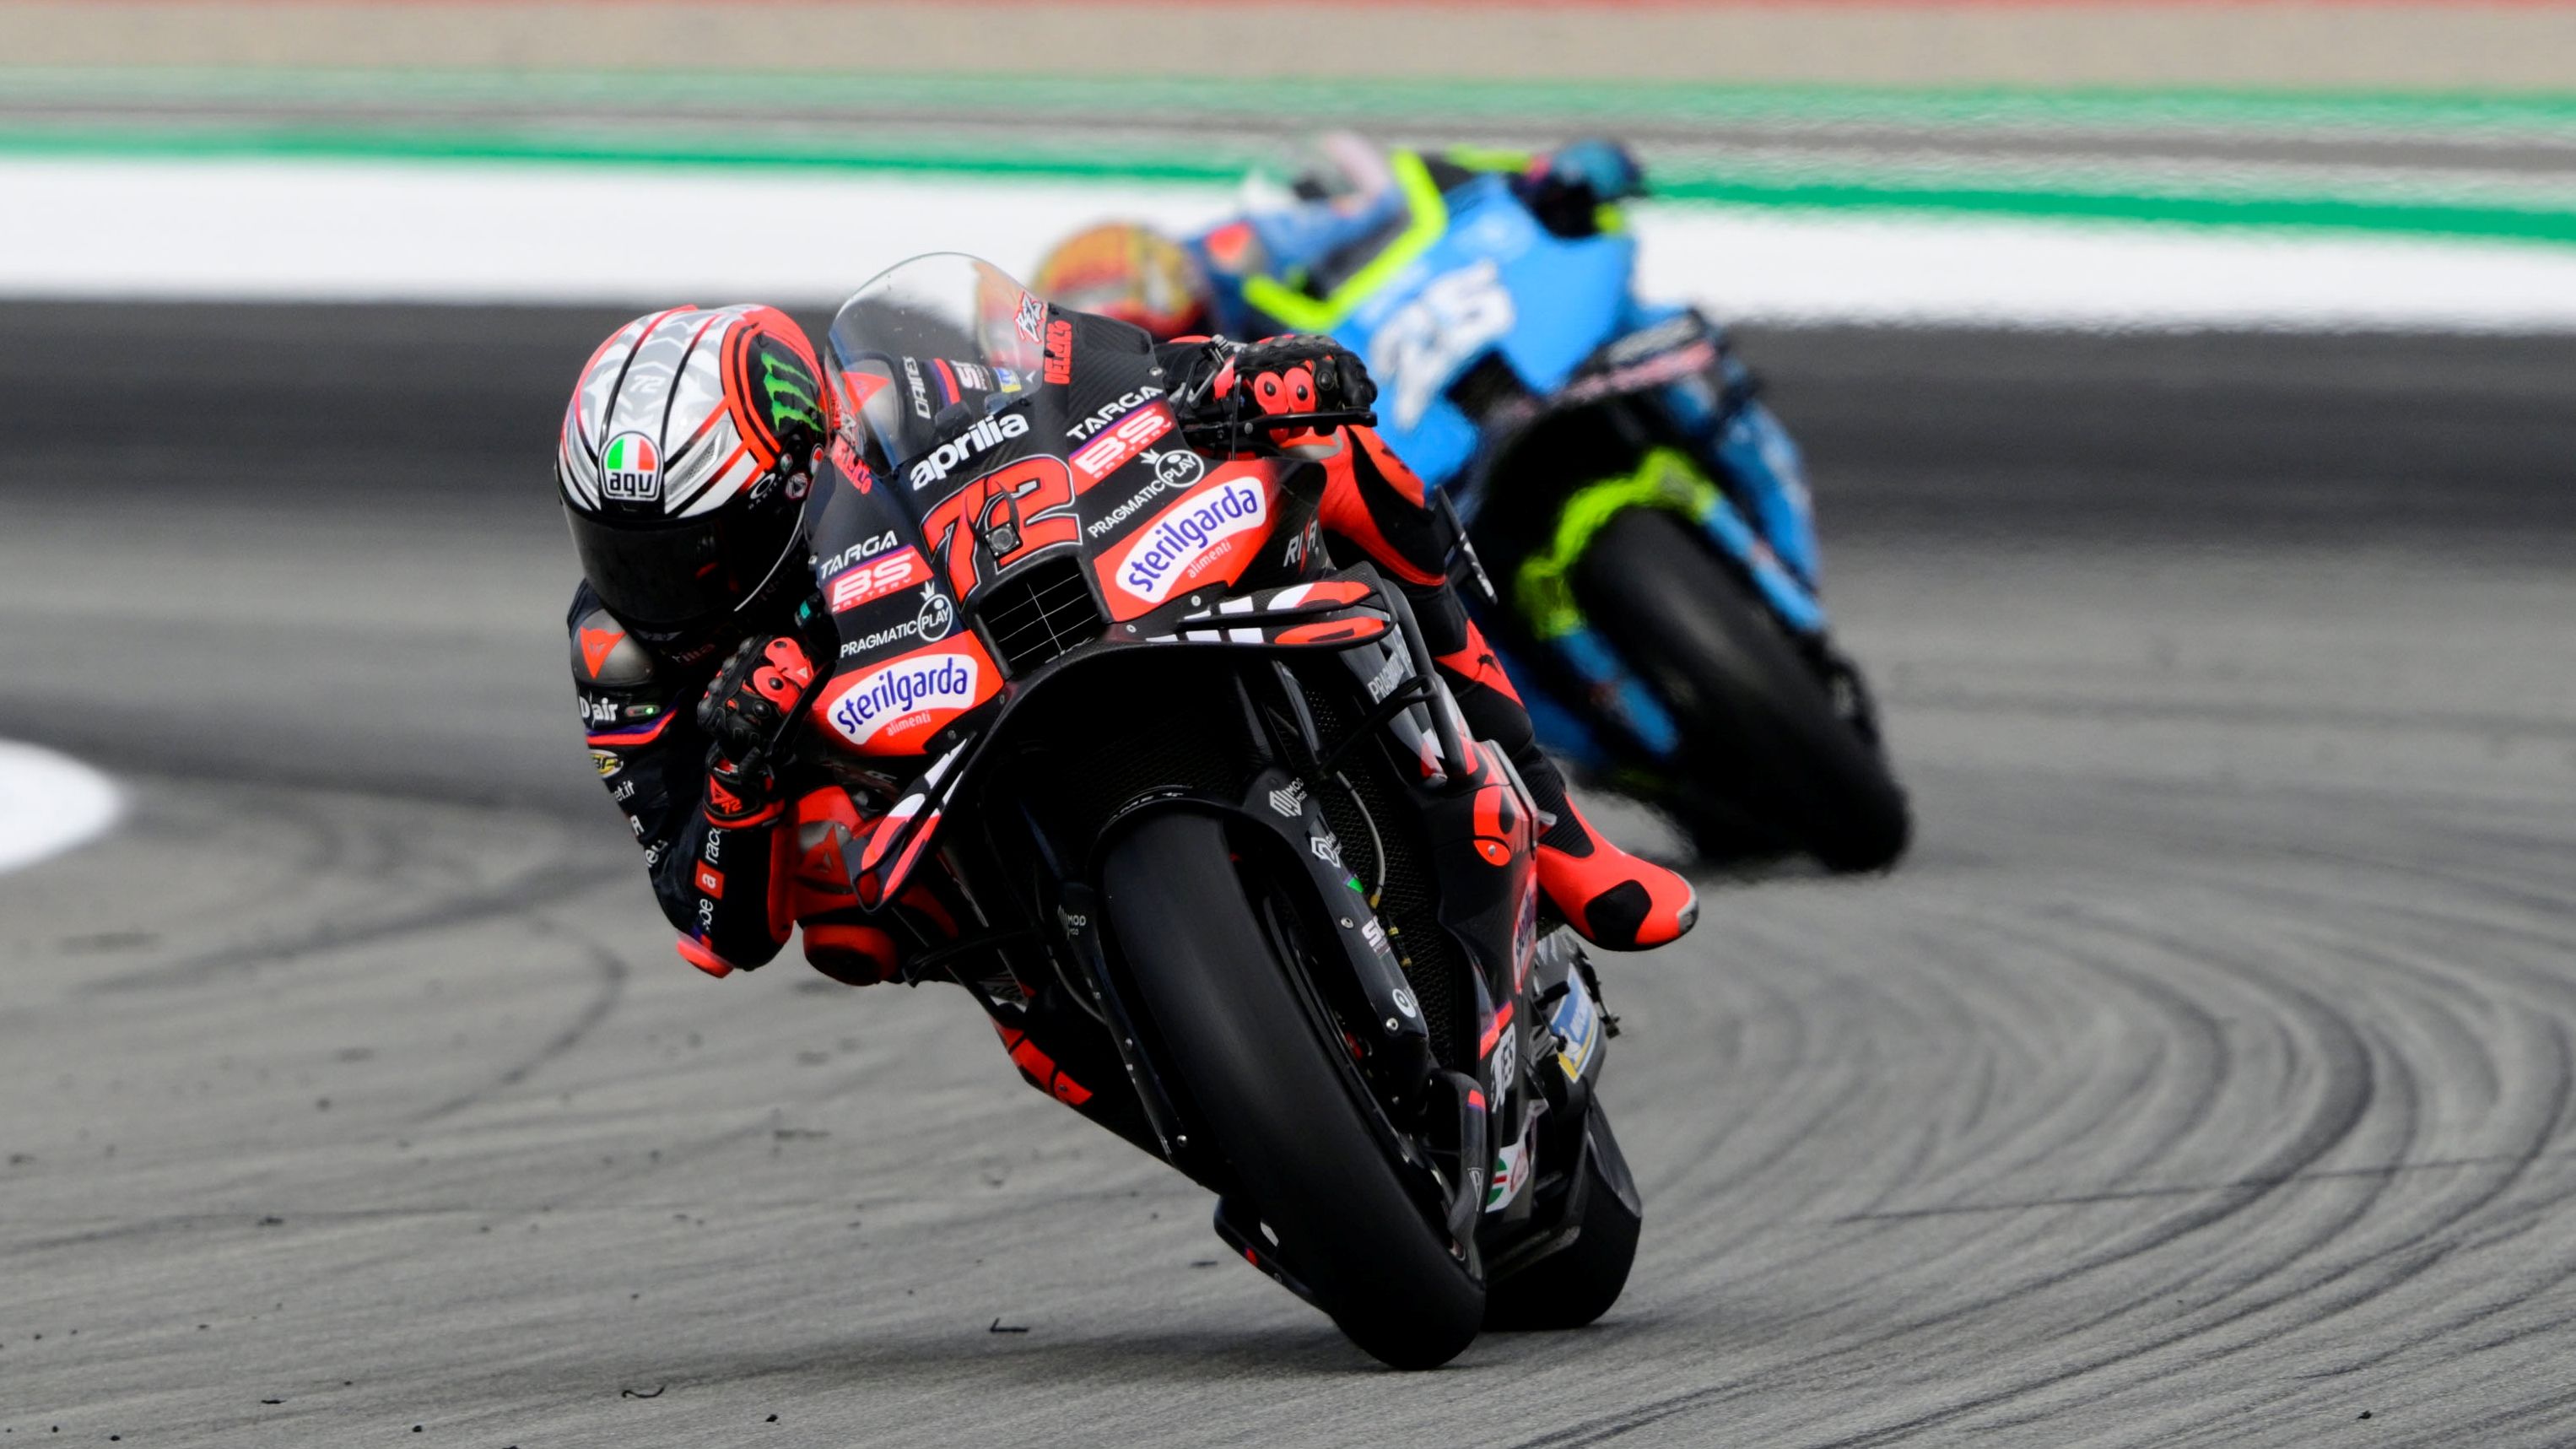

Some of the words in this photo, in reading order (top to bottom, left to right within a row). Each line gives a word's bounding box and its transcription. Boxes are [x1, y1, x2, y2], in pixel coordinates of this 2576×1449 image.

[629, 375, 665, 393] 72
[1066, 386, 1164, 441] TARGA
[910, 414, 1029, 490] aprilia
[1075, 408, 1166, 474] BS
[609, 473, 651, 496] agv
[1088, 480, 1165, 538] PRAGMATIC
[1164, 457, 1198, 484] PLAY
[819, 530, 899, 579] TARGA
[920, 454, 1083, 611] 72
[1128, 485, 1258, 592] sterilgarda
[833, 554, 913, 604] BS
[1187, 541, 1232, 578] alimenti
[840, 621, 918, 658] PRAGMATIC
[921, 608, 950, 630] PLAY
[837, 657, 968, 734] sterilgarda
[887, 712, 932, 737] alimenti
[702, 873, 716, 889] a
